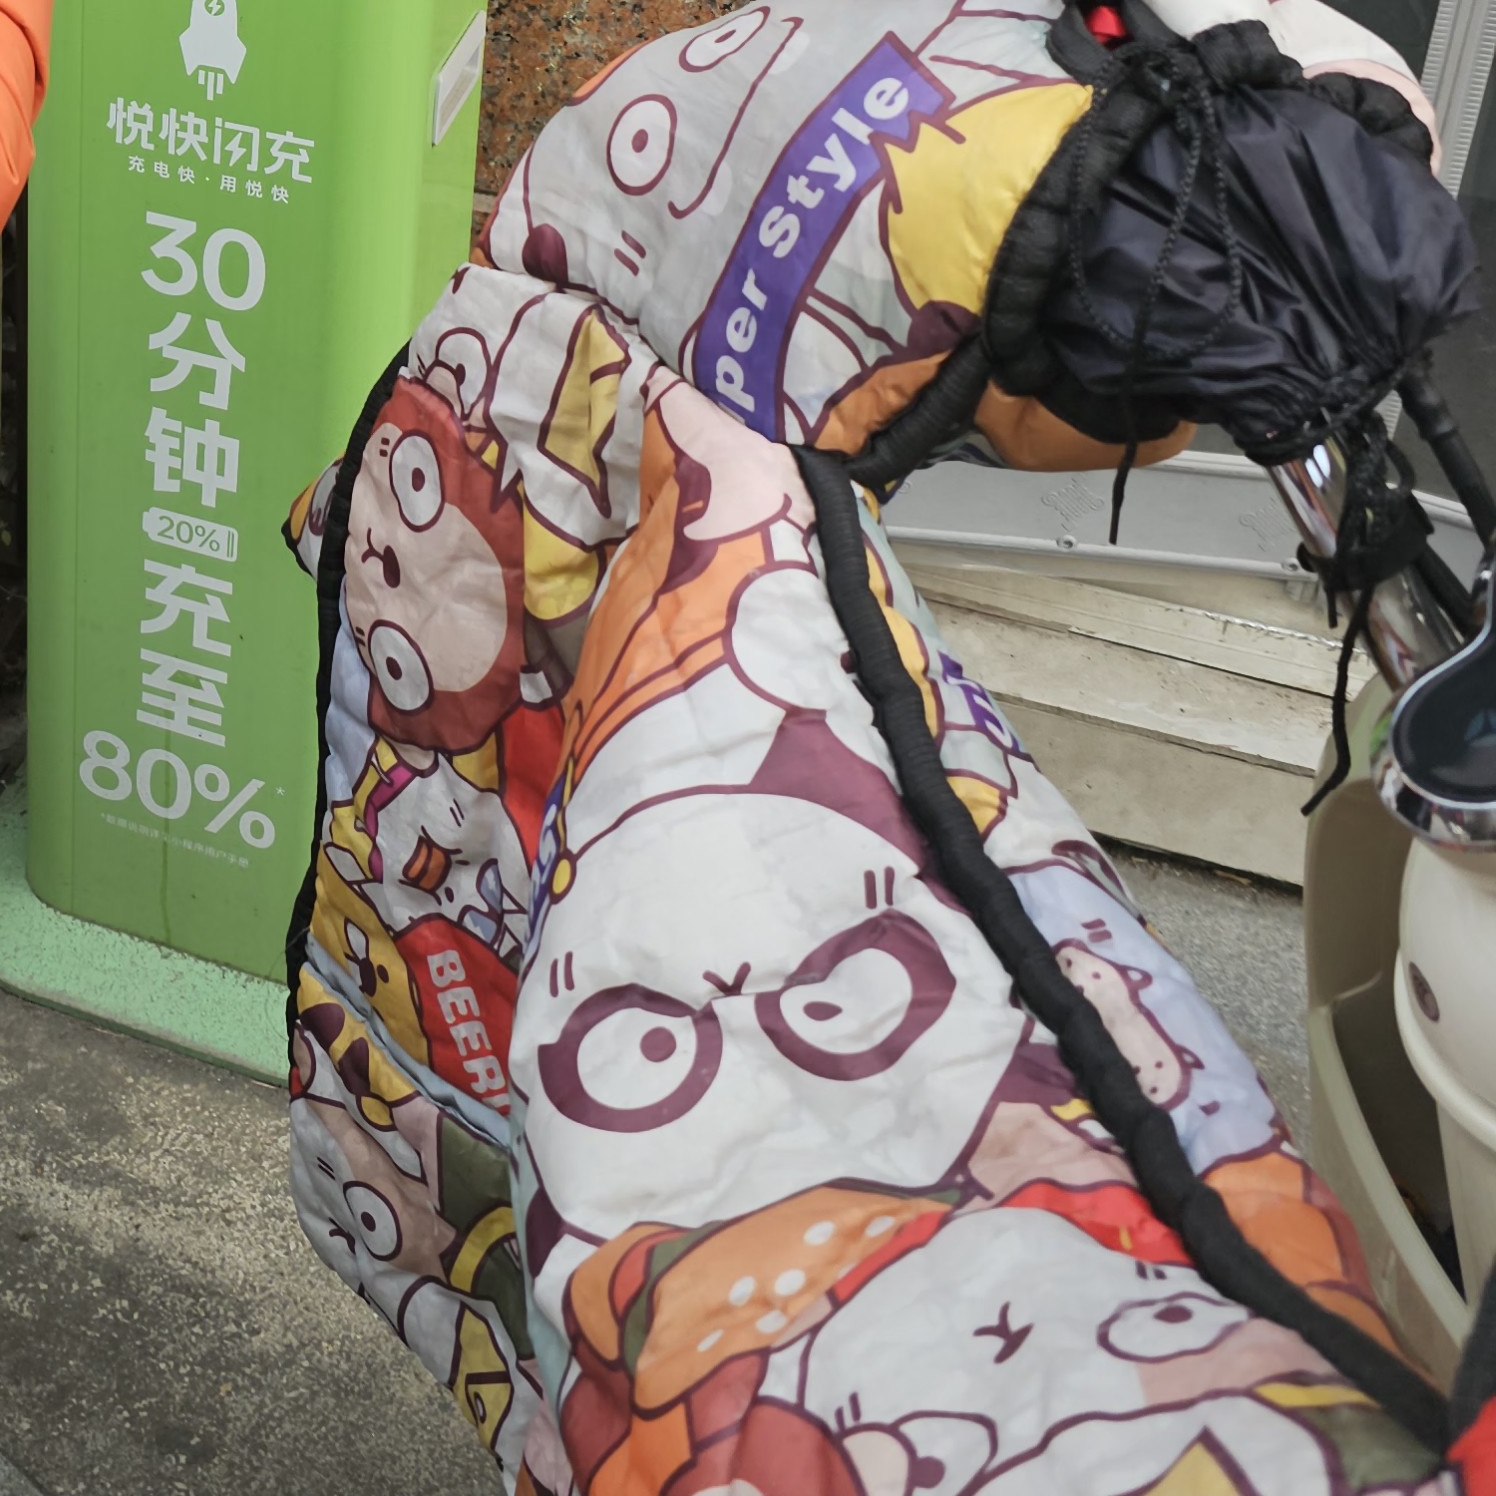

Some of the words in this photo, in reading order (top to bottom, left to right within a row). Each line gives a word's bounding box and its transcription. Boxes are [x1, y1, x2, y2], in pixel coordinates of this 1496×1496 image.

[106, 96, 315, 184] 悦快闪充
[715, 267, 768, 424] per
[758, 77, 909, 258] Style
[156, 514, 221, 553] 20%
